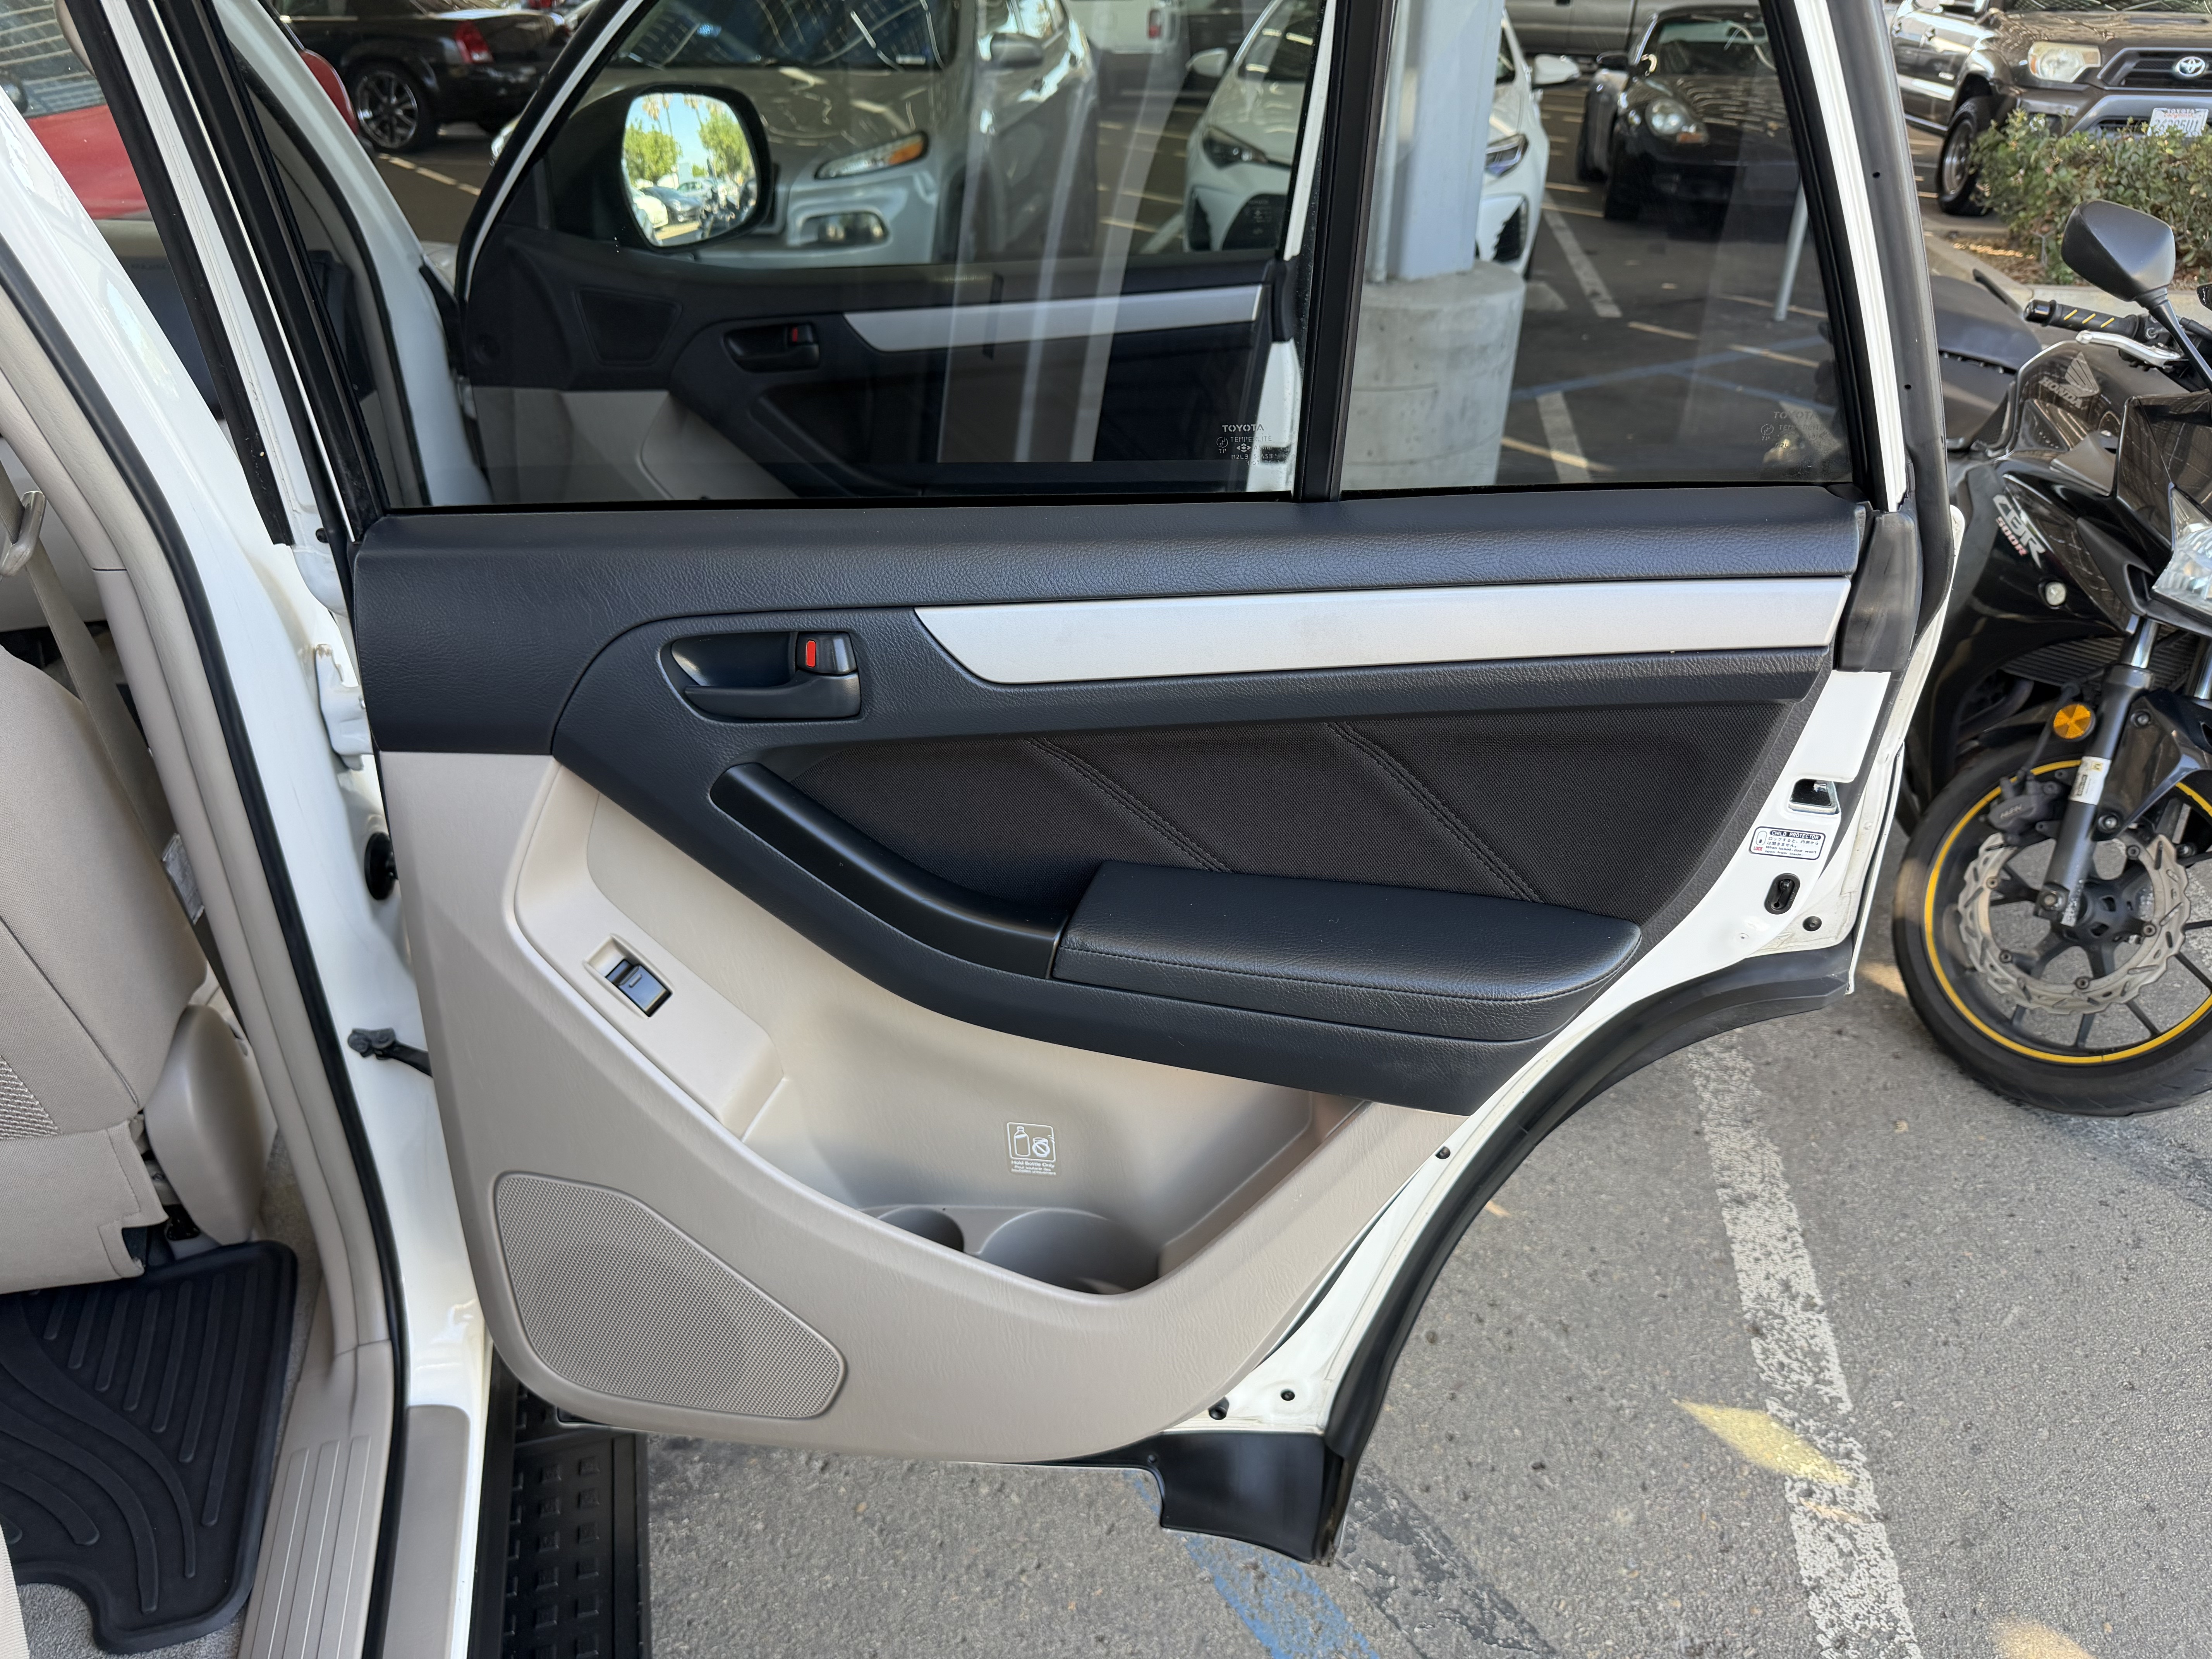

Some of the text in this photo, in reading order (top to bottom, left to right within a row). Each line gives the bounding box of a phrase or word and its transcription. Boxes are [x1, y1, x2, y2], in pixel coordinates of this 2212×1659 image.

[2039, 376, 2082, 409] HONDA
[1222, 424, 1264, 432] TOYOTA
[1993, 494, 2046, 569] CBR
